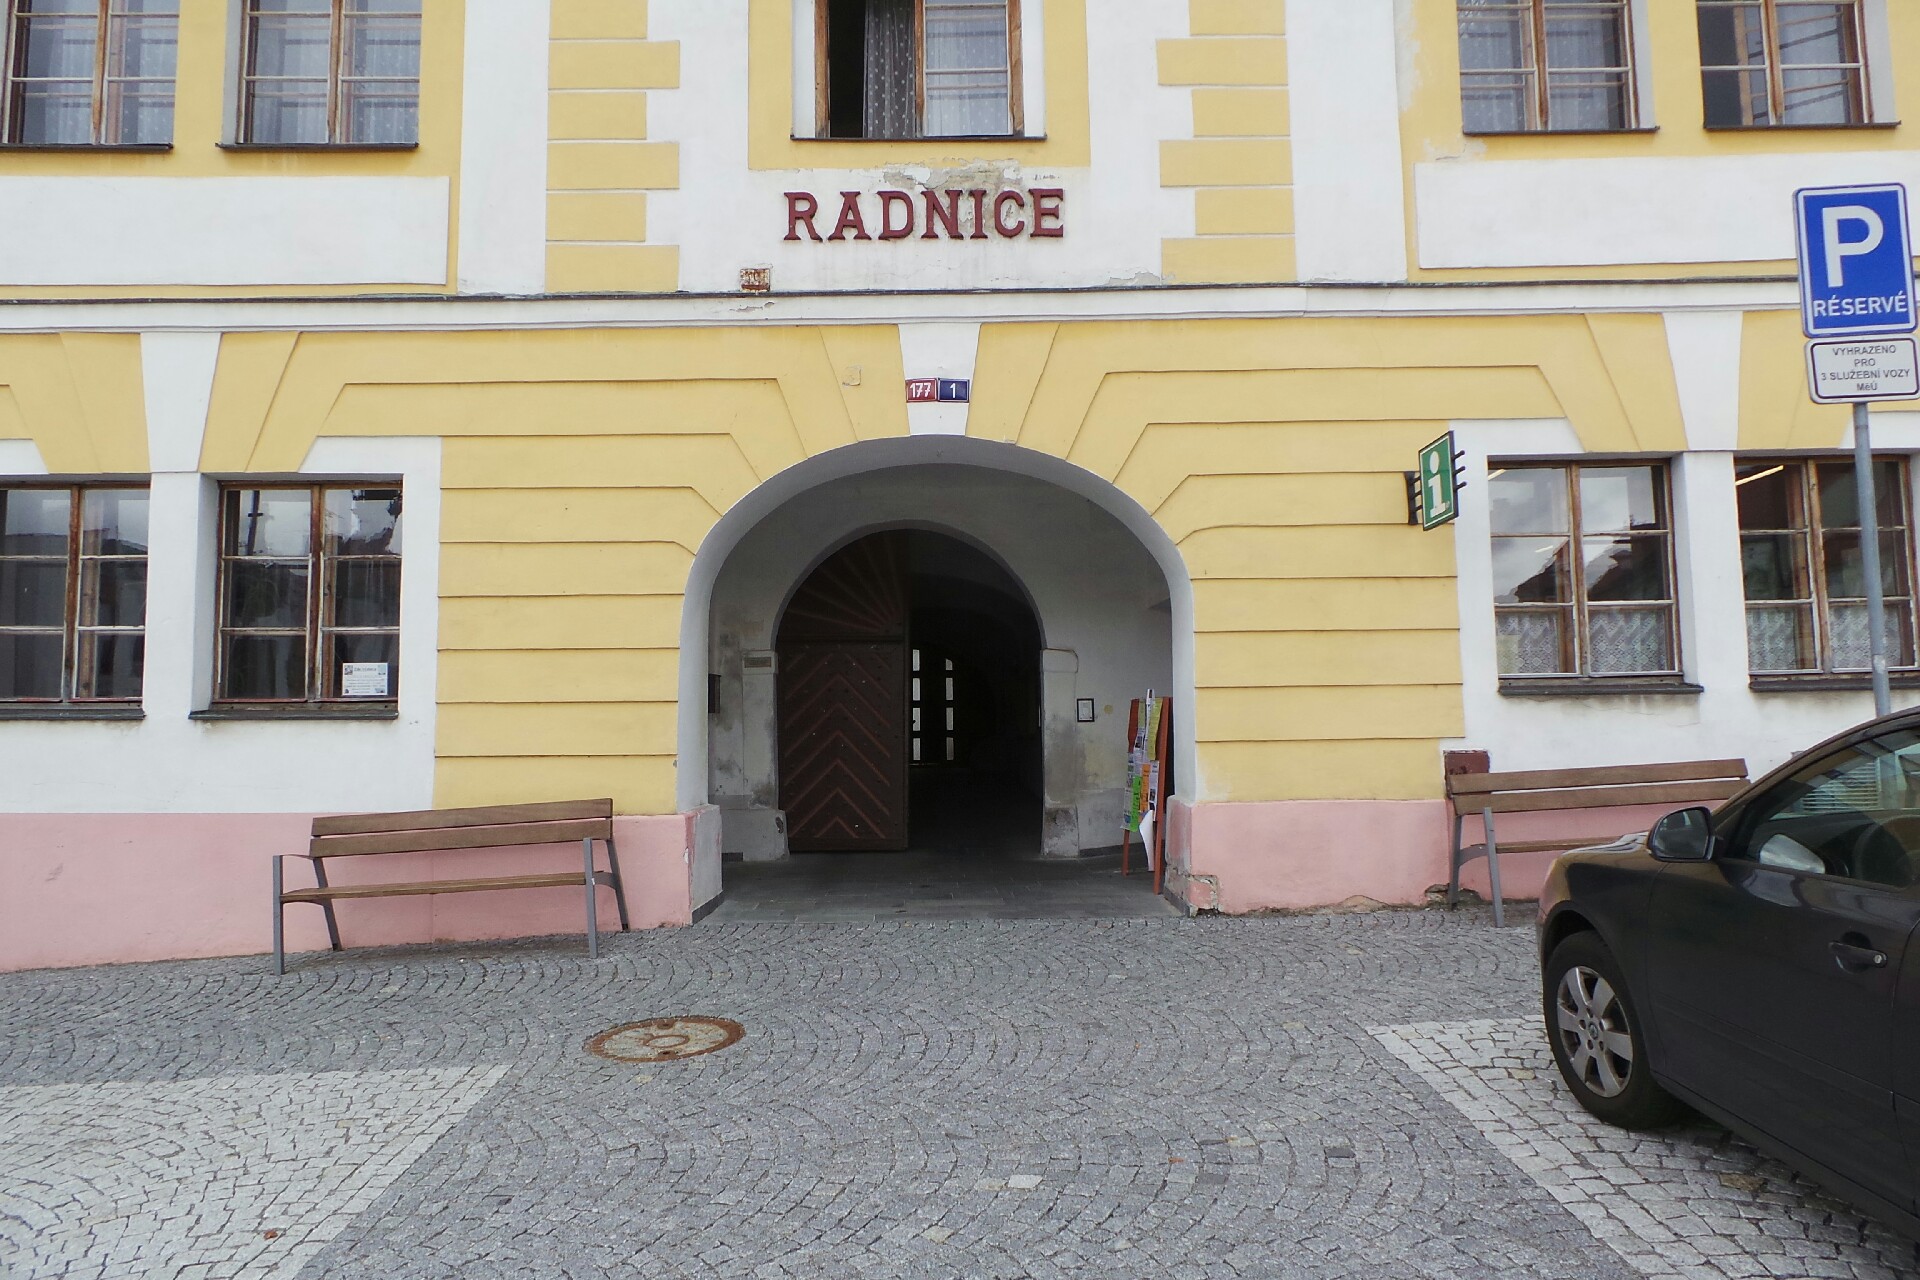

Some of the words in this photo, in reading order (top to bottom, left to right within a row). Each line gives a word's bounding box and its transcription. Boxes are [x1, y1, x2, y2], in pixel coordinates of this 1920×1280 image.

[783, 188, 1064, 242] RADNICE
[1822, 205, 1884, 288] P
[1813, 290, 1907, 317] RÉSERVÉ
[1832, 344, 1897, 356] VYHRAZENO
[1854, 358, 1876, 367] PRO
[1821, 372, 1827, 381] 3
[1883, 368, 1910, 378] VOZY
[910, 382, 931, 398] 177
[950, 383, 956, 399] 1
